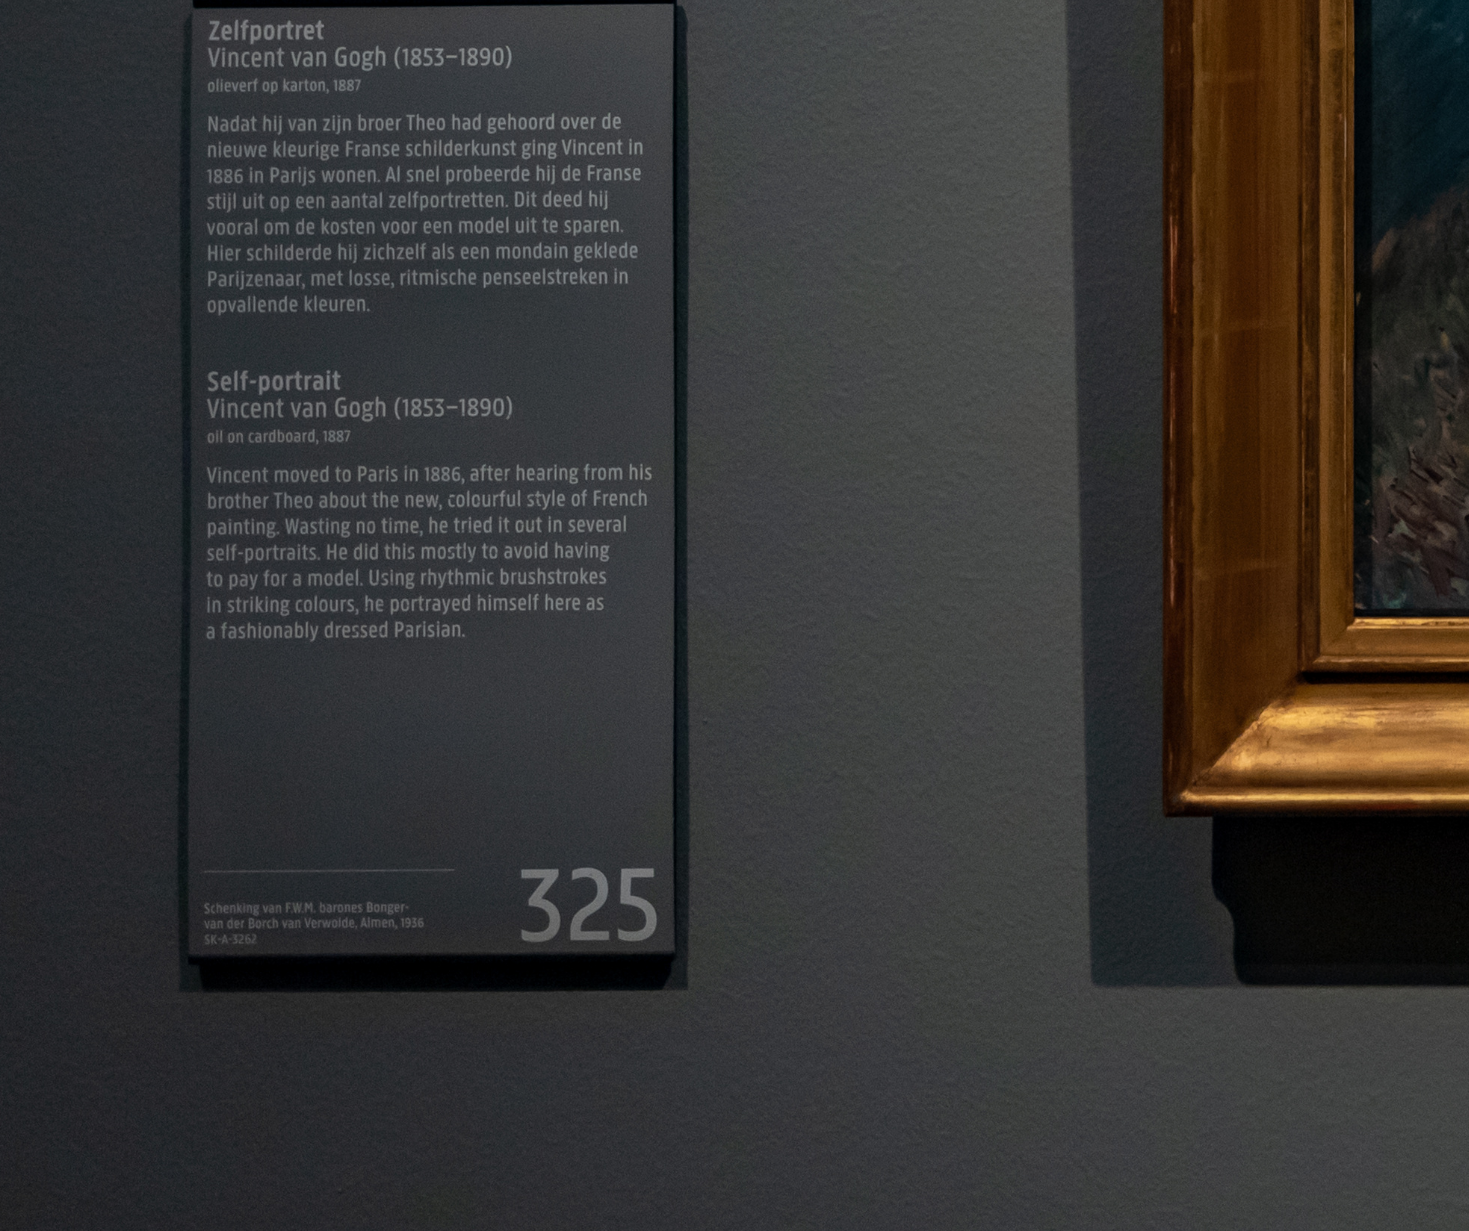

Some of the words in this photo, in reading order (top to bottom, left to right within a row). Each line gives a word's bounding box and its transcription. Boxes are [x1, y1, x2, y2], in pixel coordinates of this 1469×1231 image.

[207, 18, 326, 46] Zelfportret
[206, 46, 286, 69] Vincent
[290, 50, 328, 68] van
[333, 44, 387, 73] Gogh
[206, 77, 259, 94] olieverf
[261, 80, 279, 95] op
[281, 77, 331, 95] karton,
[332, 78, 362, 93] 1887
[207, 114, 258, 133] Nadat
[261, 114, 283, 136] hij
[287, 117, 318, 133] van
[322, 114, 353, 136] zijn
[357, 113, 403, 132] broer
[405, 113, 447, 132] Theo
[450, 112, 482, 132] had
[486, 112, 556, 135] gehoord
[559, 115, 597, 131] over
[601, 111, 622, 131] de
[206, 140, 268, 159] nieuwe
[272, 139, 340, 162] kleurige
[344, 139, 401, 158] Franse
[405, 138, 517, 158] schilderkunst
[520, 138, 558, 161] ging
[560, 138, 624, 157] Vincent
[628, 137, 644, 156] in
[206, 167, 244, 185] 1886
[248, 166, 265, 184] in
[269, 165, 317, 188] Parijs
[320, 168, 381, 184] wonen.
[384, 164, 401, 183] Al
[405, 164, 440, 184] snel
[444, 164, 531, 186] probeerde
[535, 164, 556, 186] hij
[560, 163, 582, 183] de
[586, 163, 642, 182] Franse
[206, 192, 237, 214] stijl
[242, 192, 265, 210] uit
[269, 195, 291, 213] op
[294, 194, 326, 210] een
[330, 191, 384, 210] aantal
[388, 190, 509, 212] zelfportretten.
[513, 190, 538, 209] Dit
[541, 189, 583, 209] deed
[587, 189, 609, 211] hij
[205, 217, 259, 237] vooral
[263, 221, 290, 236] om
[294, 217, 316, 236] de
[320, 217, 376, 236] kosten
[380, 220, 419, 235] voor
[422, 220, 453, 235] een
[457, 215, 510, 235] model
[514, 216, 538, 235] uit
[541, 216, 559, 234] te
[563, 218, 625, 237] sparen.
[206, 244, 242, 262] Hier
[246, 243, 333, 262] schilderde
[337, 242, 358, 264] hij
[362, 241, 427, 261] zichzelf
[431, 242, 456, 261] als
[459, 245, 491, 261] een
[495, 241, 569, 260] mondain
[573, 240, 639, 264] geklede
[206, 269, 306, 291] Parijzenaar,
[310, 269, 344, 287] met
[348, 268, 396, 289] losse,
[399, 267, 478, 287] ritmische
[482, 267, 609, 289] penseelstreken
[613, 267, 629, 285] in
[206, 294, 299, 317] opvallende
[303, 294, 371, 313] kleuren.
[206, 369, 342, 396] Self-portrait
[206, 397, 285, 420] Vincent
[289, 400, 328, 419] van
[333, 395, 387, 423] Gogh
[206, 428, 224, 445] oil
[226, 431, 245, 445] on
[247, 428, 320, 446] cardboard,
[322, 428, 352, 444] 1887
[205, 466, 270, 484] Vincent
[273, 464, 330, 484] moved
[334, 465, 352, 484] to
[356, 464, 399, 483] Paris
[403, 464, 420, 483] in
[423, 465, 466, 486] 1886,
[469, 463, 511, 483] after
[515, 463, 580, 486] hearing
[582, 462, 624, 482] from
[628, 462, 653, 482] his
[206, 491, 270, 510] brother
[272, 491, 314, 510] Theo
[318, 490, 368, 510] about
[371, 490, 400, 509] the
[404, 493, 443, 511] new,
[447, 489, 522, 509] colourful
[526, 488, 567, 511] style
[570, 488, 588, 508] of
[592, 488, 649, 508] French
[206, 517, 281, 540] painting.
[284, 517, 352, 539] Wasting
[355, 520, 377, 535] no
[380, 516, 424, 538] time,
[428, 515, 449, 535] he
[452, 515, 493, 535] tried
[497, 515, 511, 534] it
[514, 516, 543, 534] out
[547, 515, 563, 534] in
[567, 514, 628, 534] several
[206, 543, 321, 565] self-portraits.
[325, 542, 349, 561] He
[352, 542, 379, 561] did
[383, 542, 416, 561] this
[420, 541, 477, 564] mostly
[480, 542, 499, 560] to
[502, 540, 549, 560] avoid
[553, 541, 611, 563] having
[205, 570, 224, 588] to
[228, 573, 259, 591] pay
[262, 568, 288, 588] for
[292, 572, 303, 588] a
[307, 568, 364, 587] model.
[368, 568, 416, 591] Using
[420, 567, 495, 590] rhythmic
[499, 566, 608, 586] brushstrokes
[206, 595, 222, 614] in
[226, 595, 291, 618] striking
[294, 594, 360, 616] colours,
[363, 594, 385, 613] he
[389, 593, 472, 616] portrayed
[476, 592, 540, 612] himself
[543, 592, 582, 612] here
[585, 596, 605, 612] as
[205, 625, 216, 641] a
[219, 620, 320, 643] fashionably
[323, 620, 389, 640] dressed
[393, 620, 466, 639] Parisian.
[203, 901, 261, 917] Schenking
[261, 903, 283, 915] van
[318, 901, 364, 914] barones
[519, 866, 658, 944] 325
[203, 919, 224, 930] van
[226, 917, 245, 930] der
[247, 916, 280, 930] Borch
[281, 918, 302, 930] van
[400, 916, 425, 929] 1936
